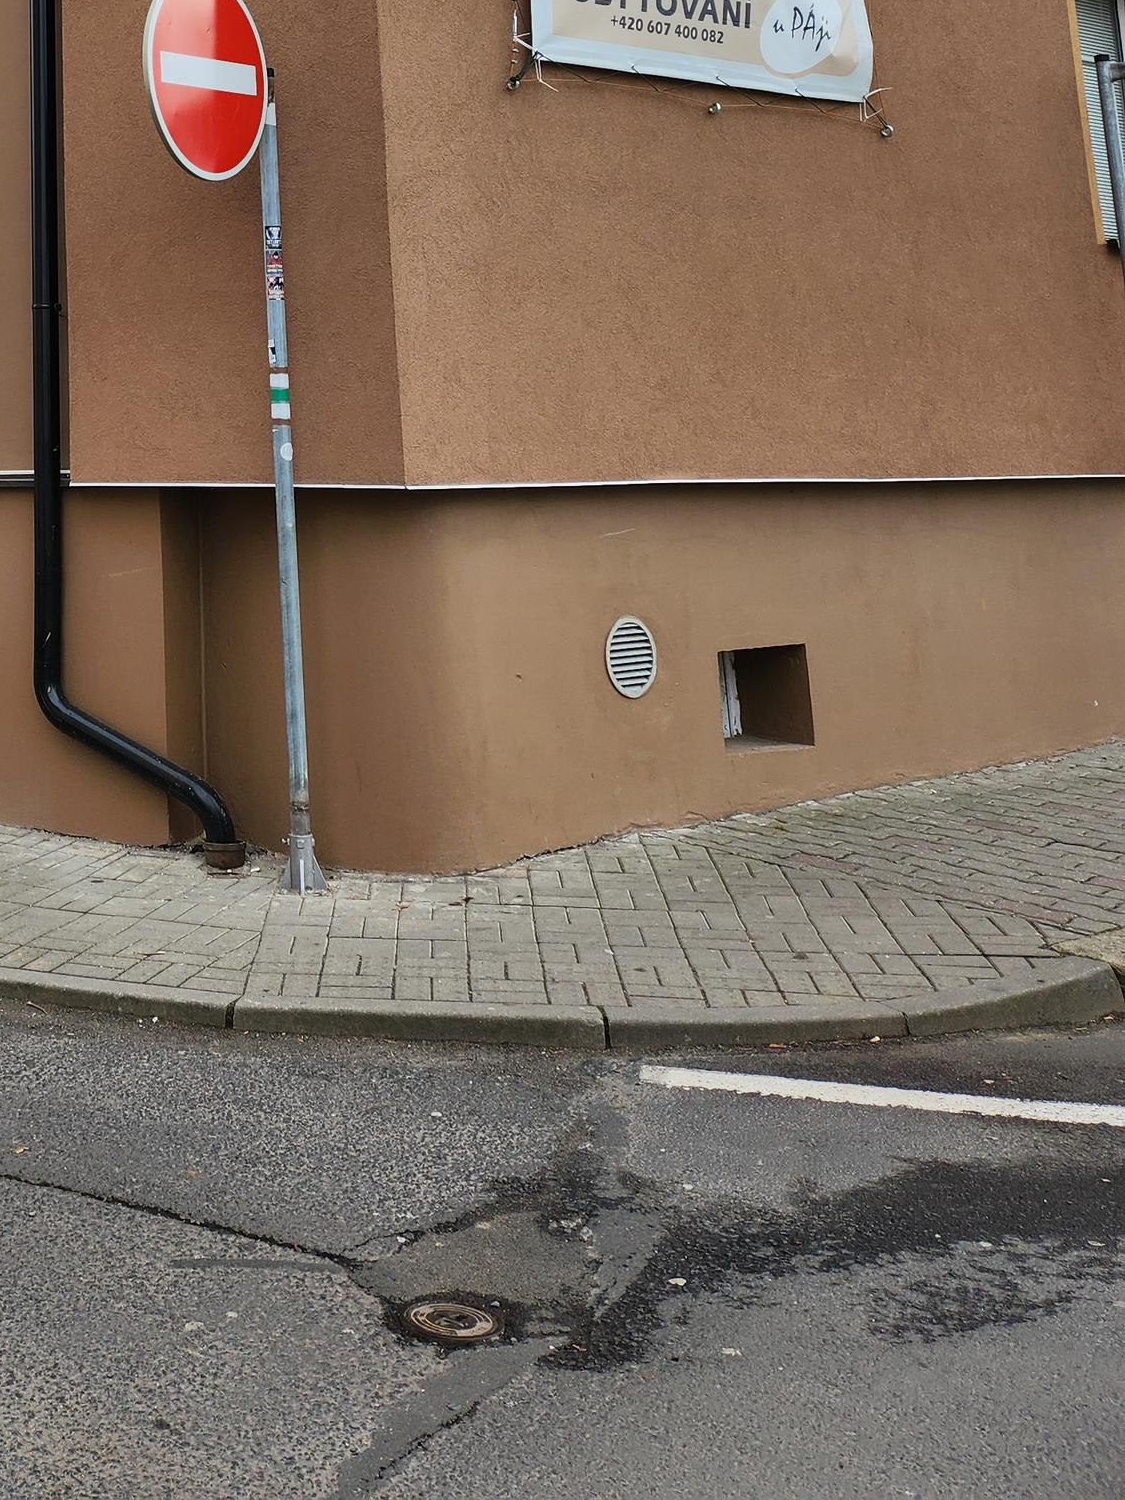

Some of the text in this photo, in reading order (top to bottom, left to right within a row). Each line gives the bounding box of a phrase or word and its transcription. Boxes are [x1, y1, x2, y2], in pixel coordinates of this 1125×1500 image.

[610, 14, 724, 44] +420 607 400 082
